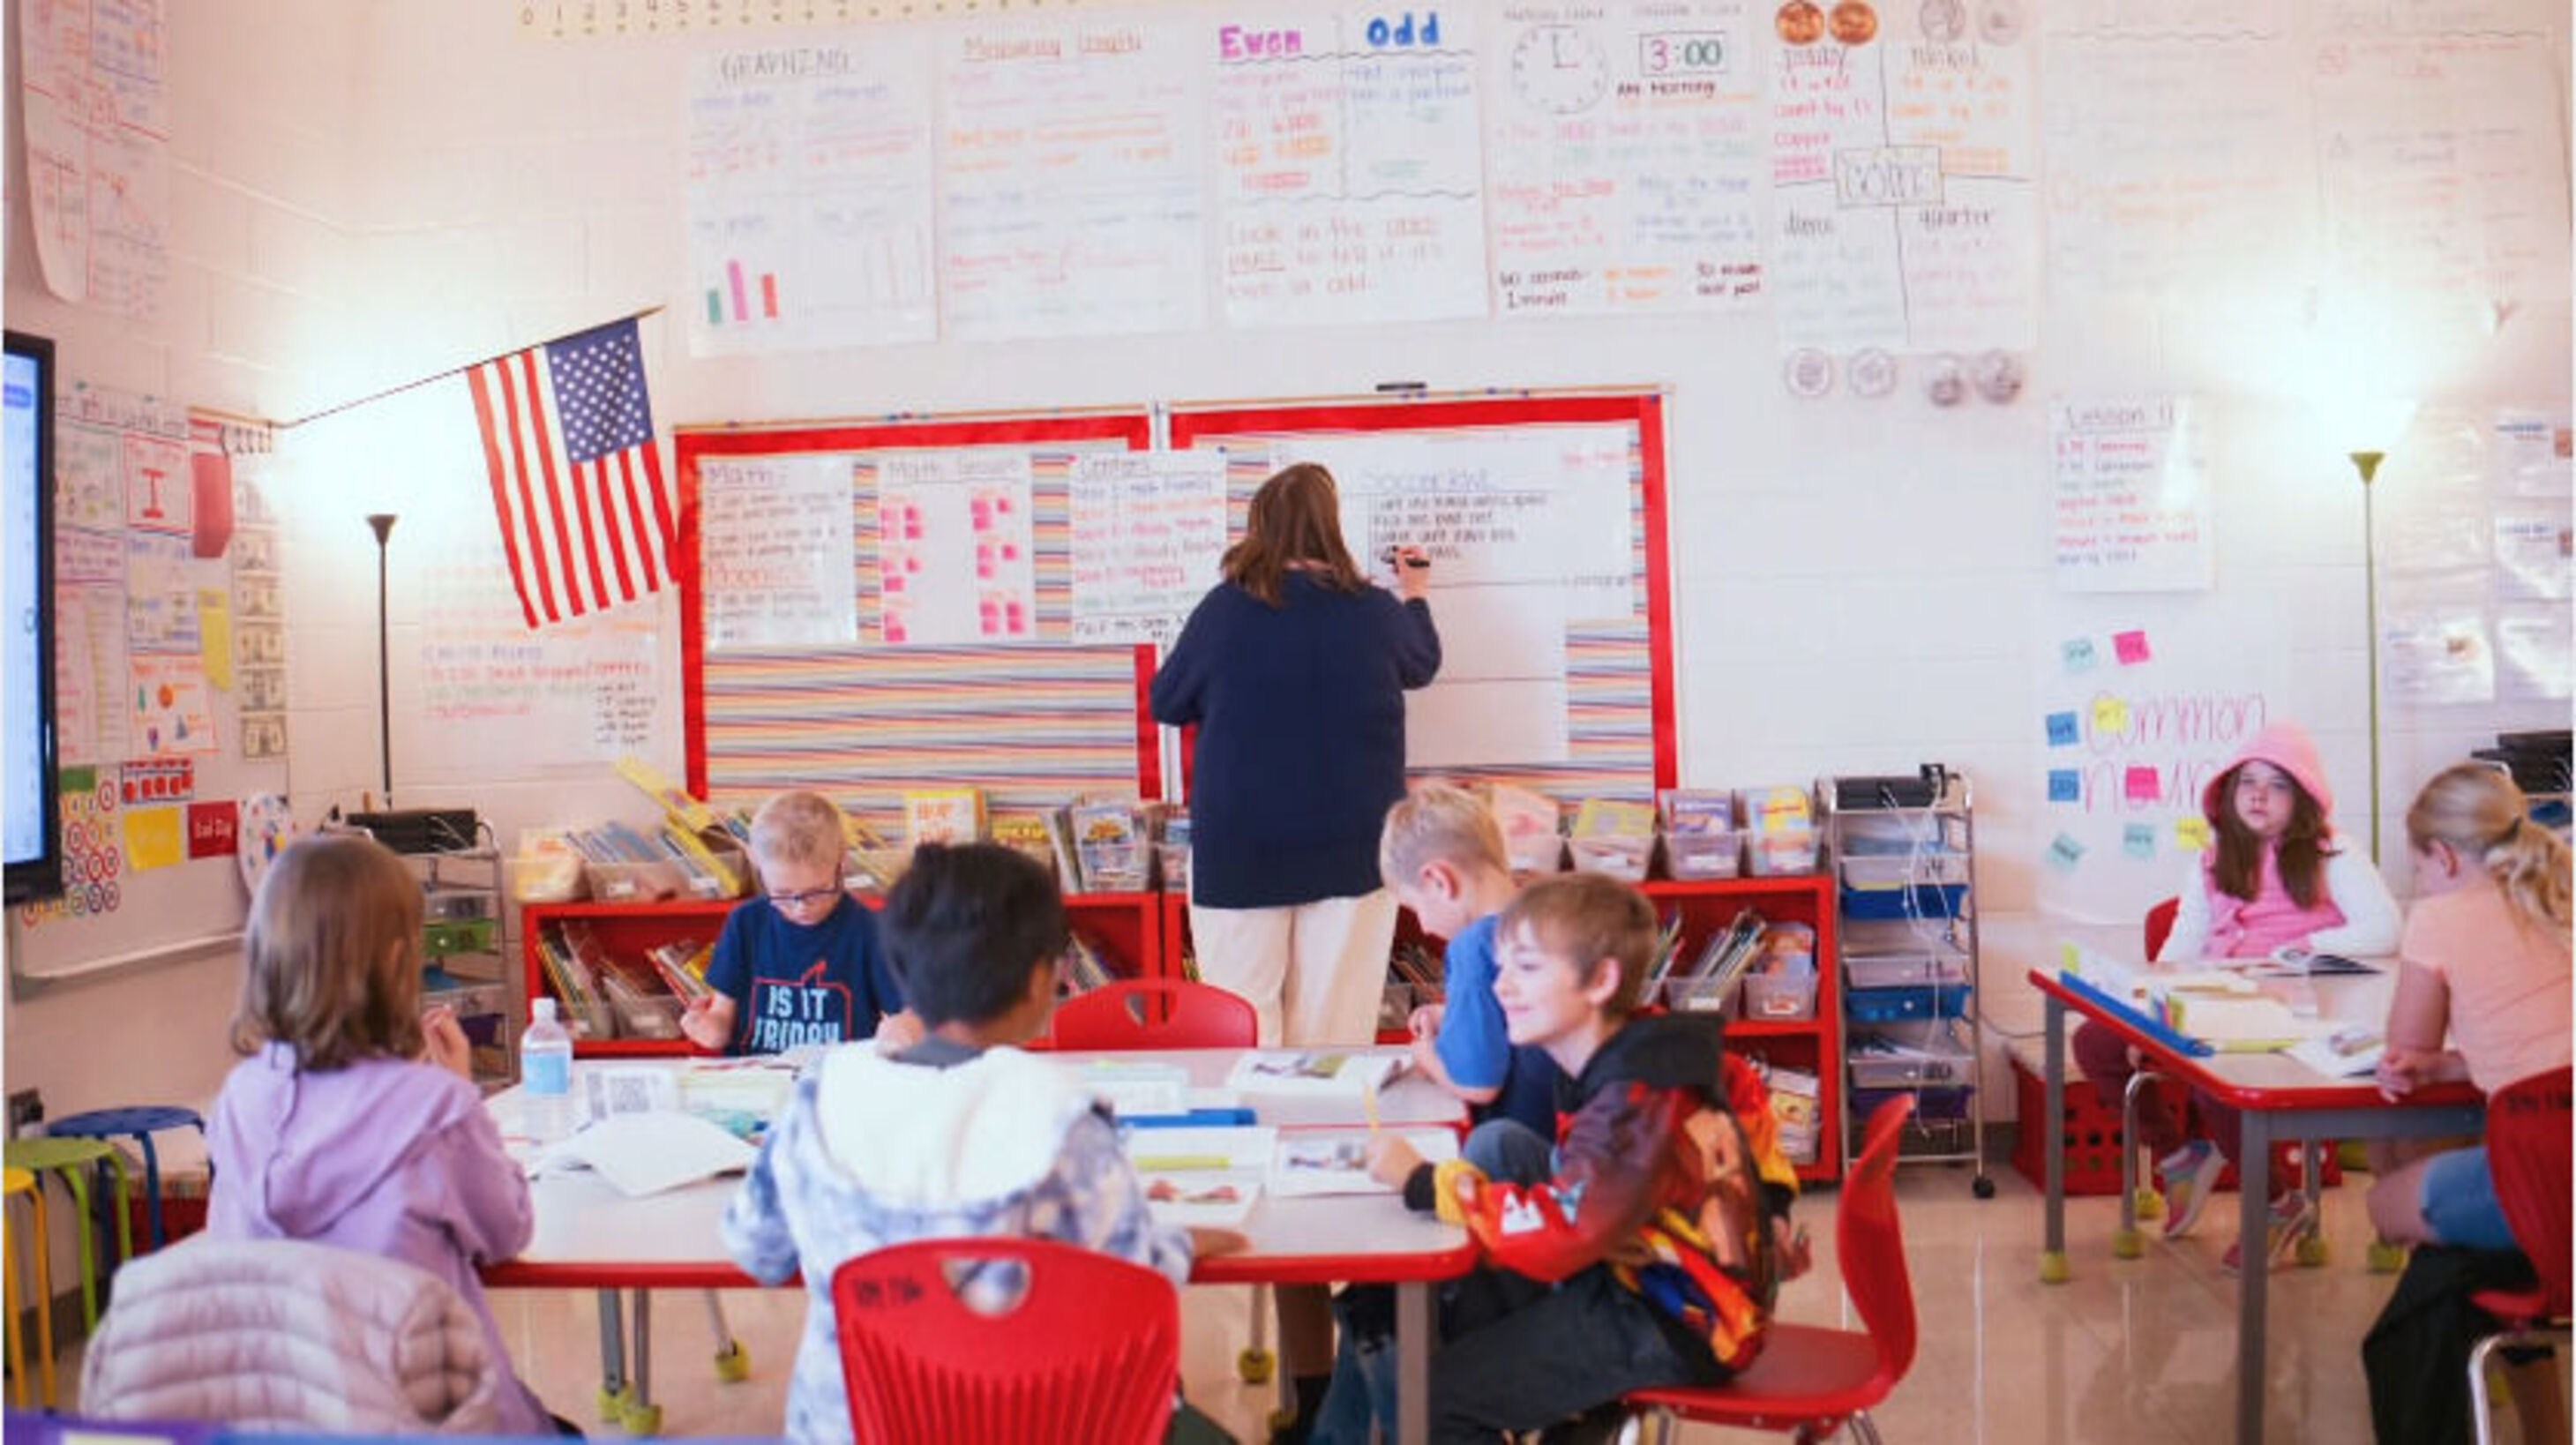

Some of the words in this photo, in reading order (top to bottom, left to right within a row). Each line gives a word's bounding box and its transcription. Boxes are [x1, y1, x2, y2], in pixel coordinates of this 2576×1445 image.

[1219, 24, 1301, 59] Even
[1366, 11, 1441, 47] Odd
[1649, 38, 1723, 71] 3:00
[768, 985, 793, 1018] IS
[801, 988, 828, 1021] IT
